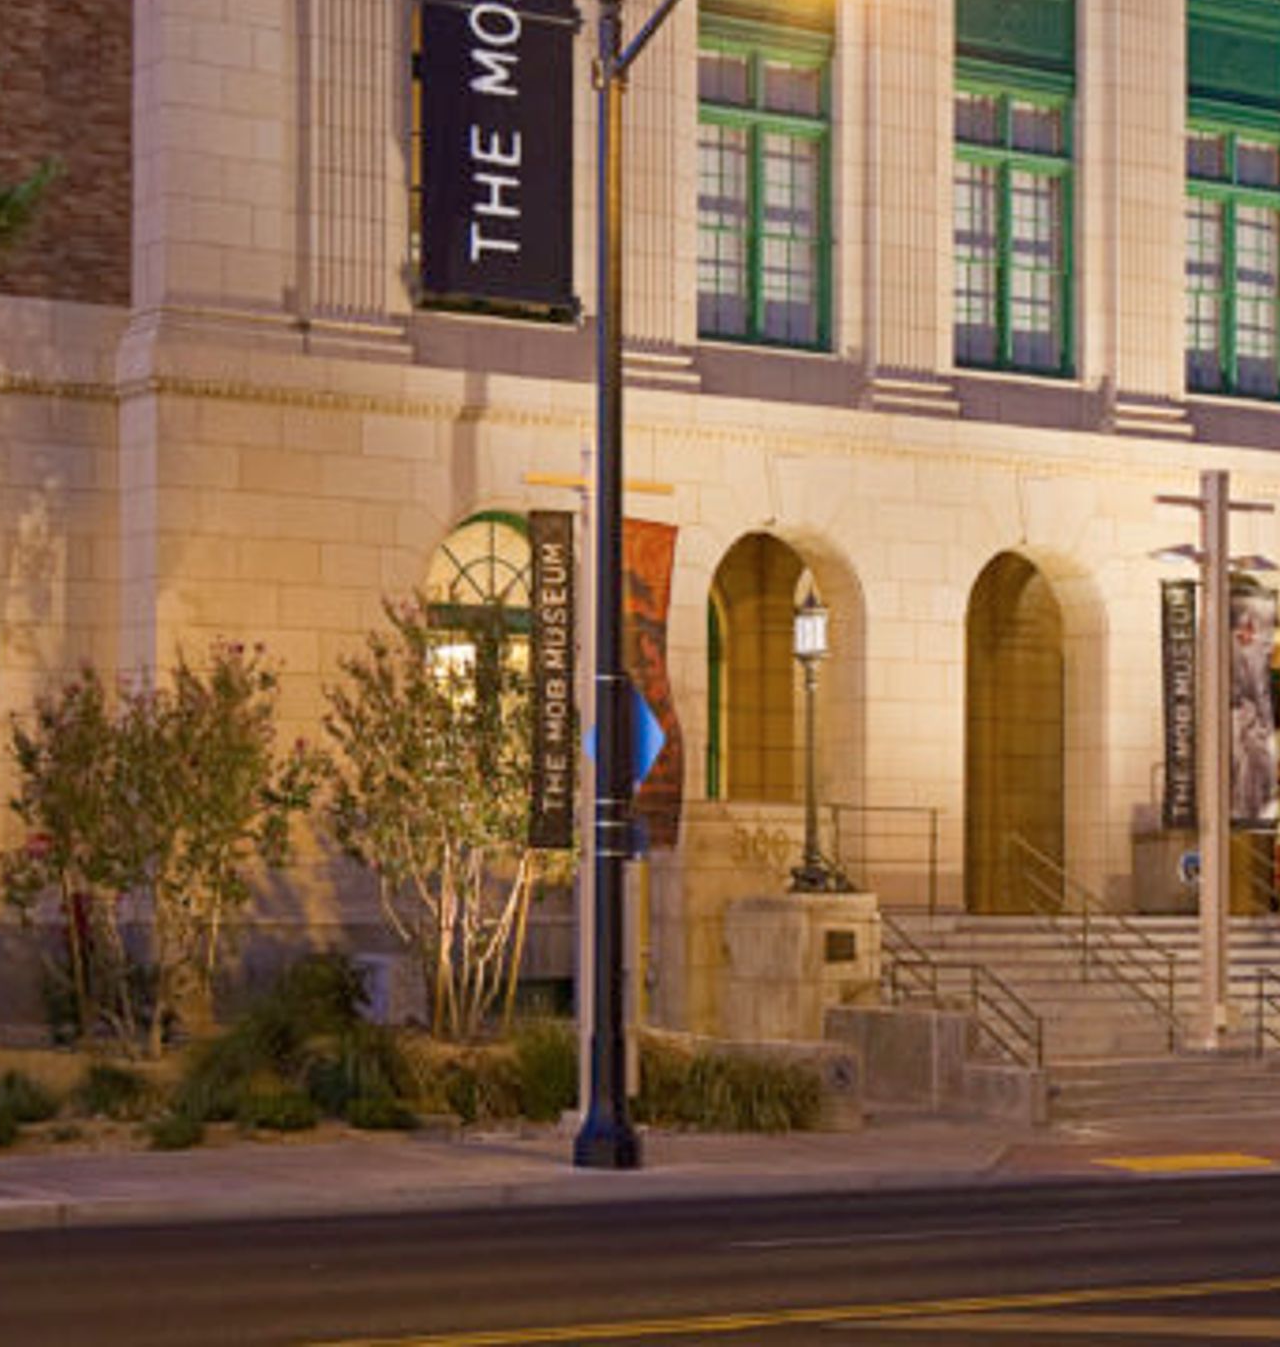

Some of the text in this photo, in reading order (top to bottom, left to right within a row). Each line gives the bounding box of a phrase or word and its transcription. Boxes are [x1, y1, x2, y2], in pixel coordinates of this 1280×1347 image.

[471, 130, 521, 262] THE
[541, 543, 567, 814] THE MOB MUSEUM
[1169, 588, 1191, 696] MUSEUM
